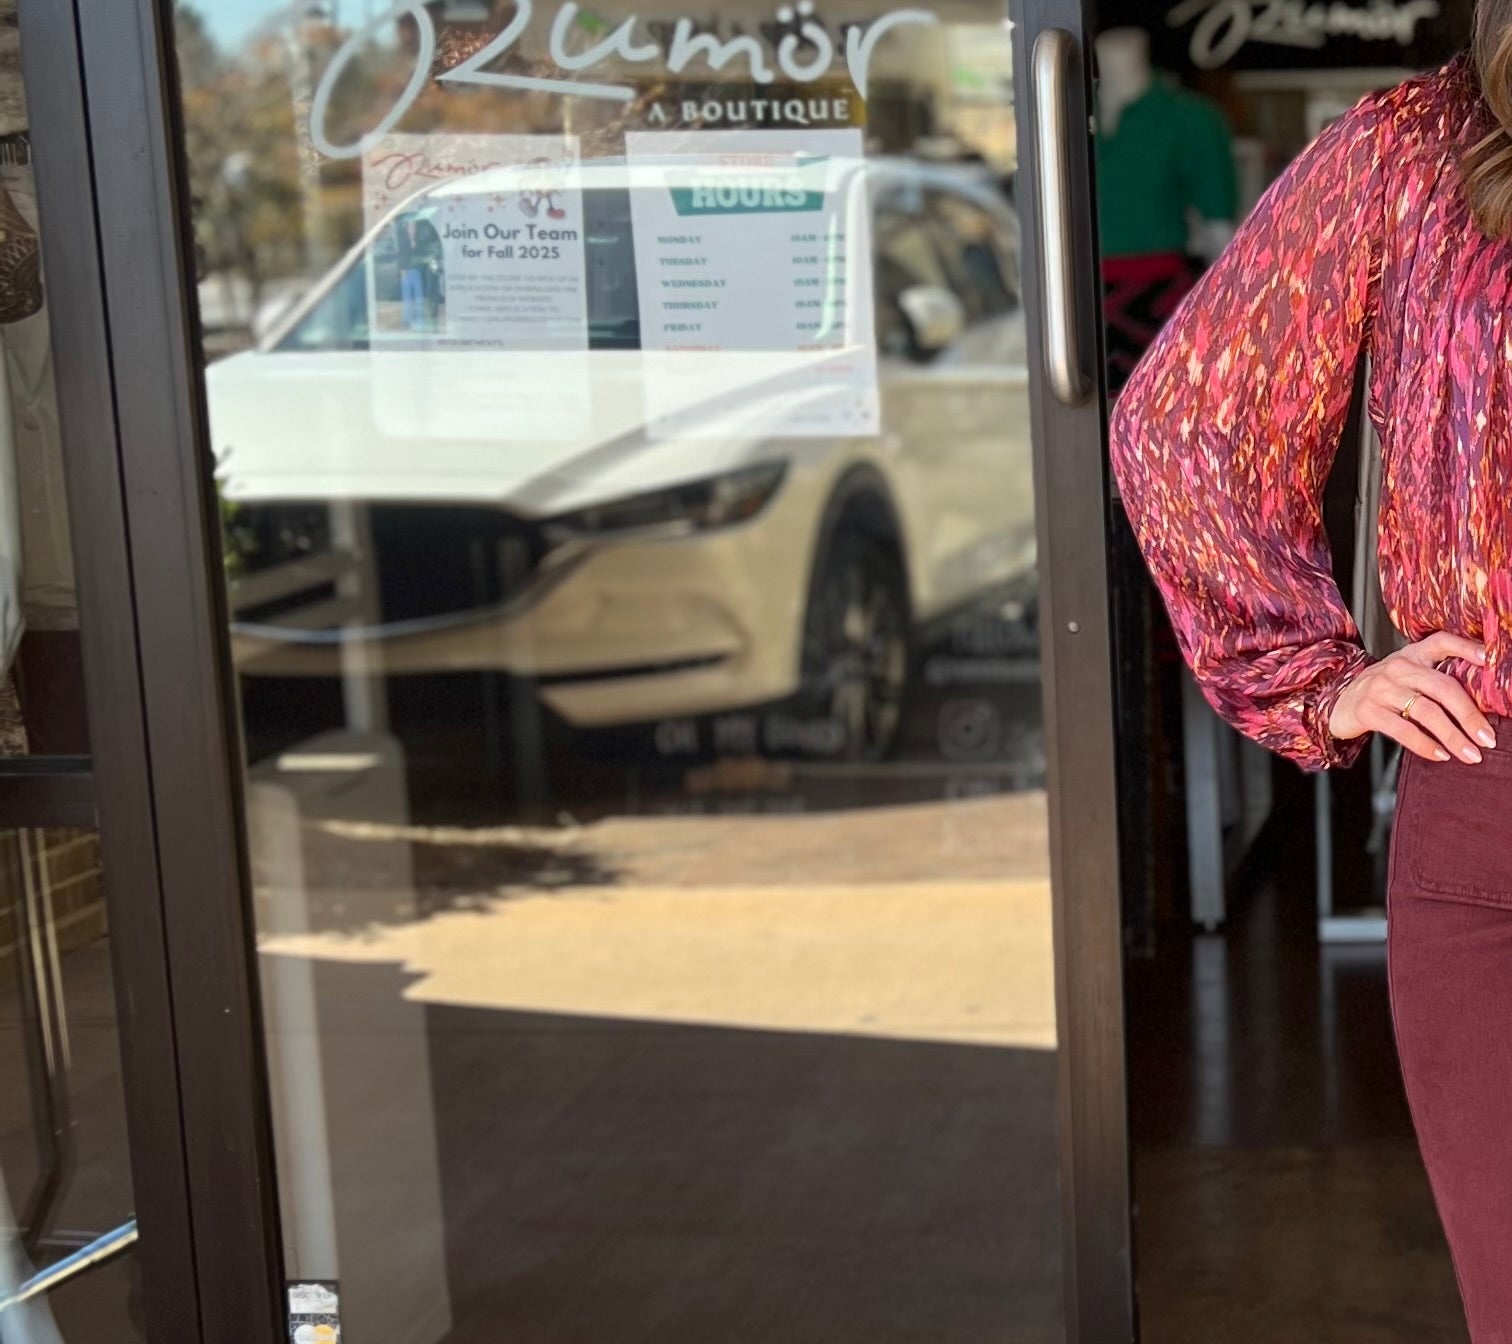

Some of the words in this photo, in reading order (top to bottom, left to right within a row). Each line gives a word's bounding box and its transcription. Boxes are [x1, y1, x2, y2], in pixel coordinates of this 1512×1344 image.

[648, 102, 667, 123] A
[680, 99, 849, 125] BOUTIQUE
[690, 175, 808, 209] HOURS
[443, 223, 479, 240] Join
[483, 223, 521, 240] Our
[525, 223, 578, 241] Team
[462, 244, 483, 259] for
[487, 244, 514, 259] Fall
[518, 245, 561, 260] 2025
